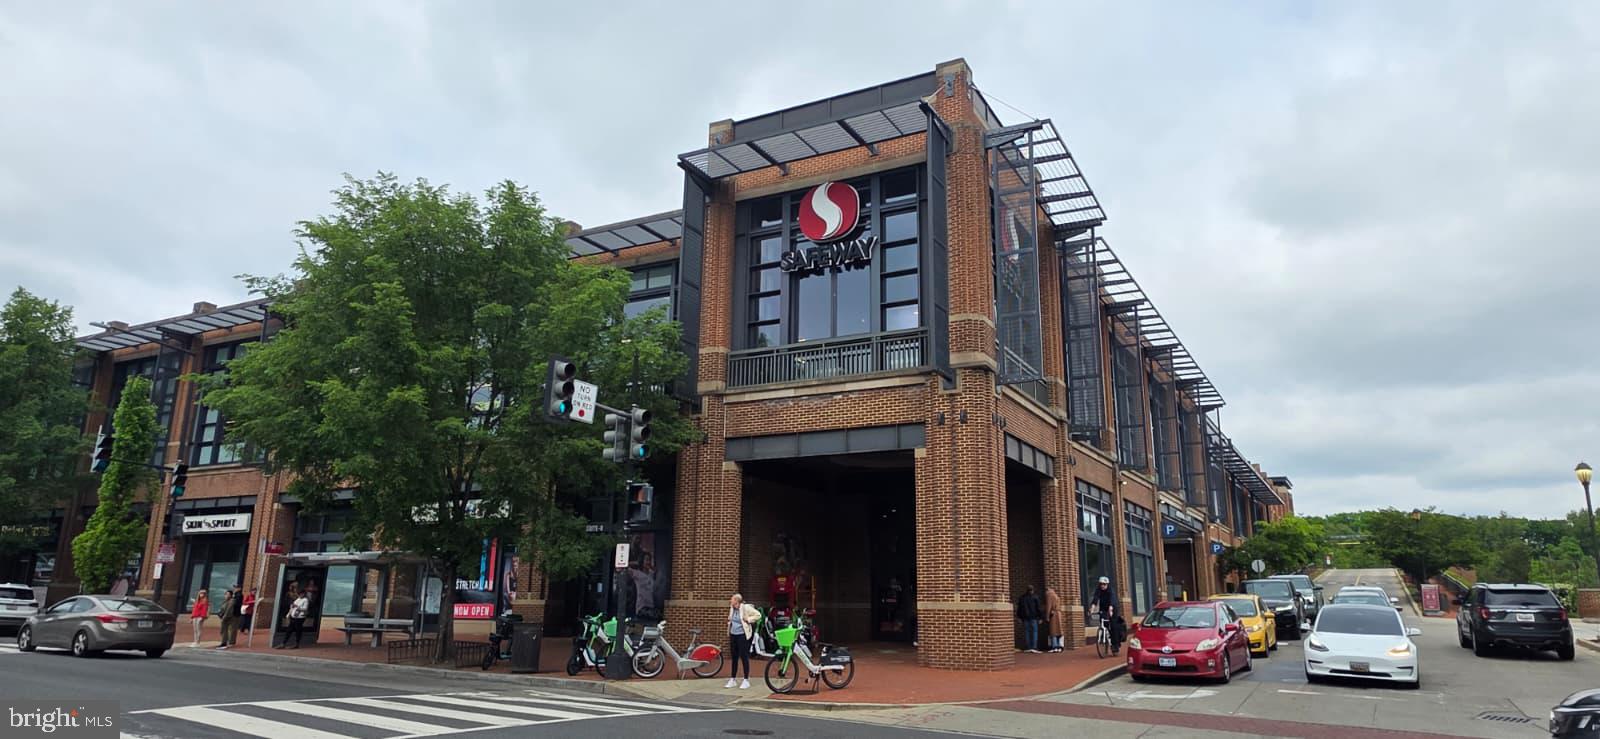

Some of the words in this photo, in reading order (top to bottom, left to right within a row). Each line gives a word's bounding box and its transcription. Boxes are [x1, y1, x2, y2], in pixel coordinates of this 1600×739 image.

[780, 236, 878, 273] SAFEWAY
[580, 385, 591, 394] NO
[577, 392, 592, 401] TURN
[582, 402, 593, 411] RED
[185, 520, 203, 529] SKIN
[211, 518, 237, 529] SPIRIT
[1166, 524, 1175, 535] P
[1213, 543, 1221, 553] P
[453, 605, 469, 616] NOW
[471, 606, 490, 616] OPEN
